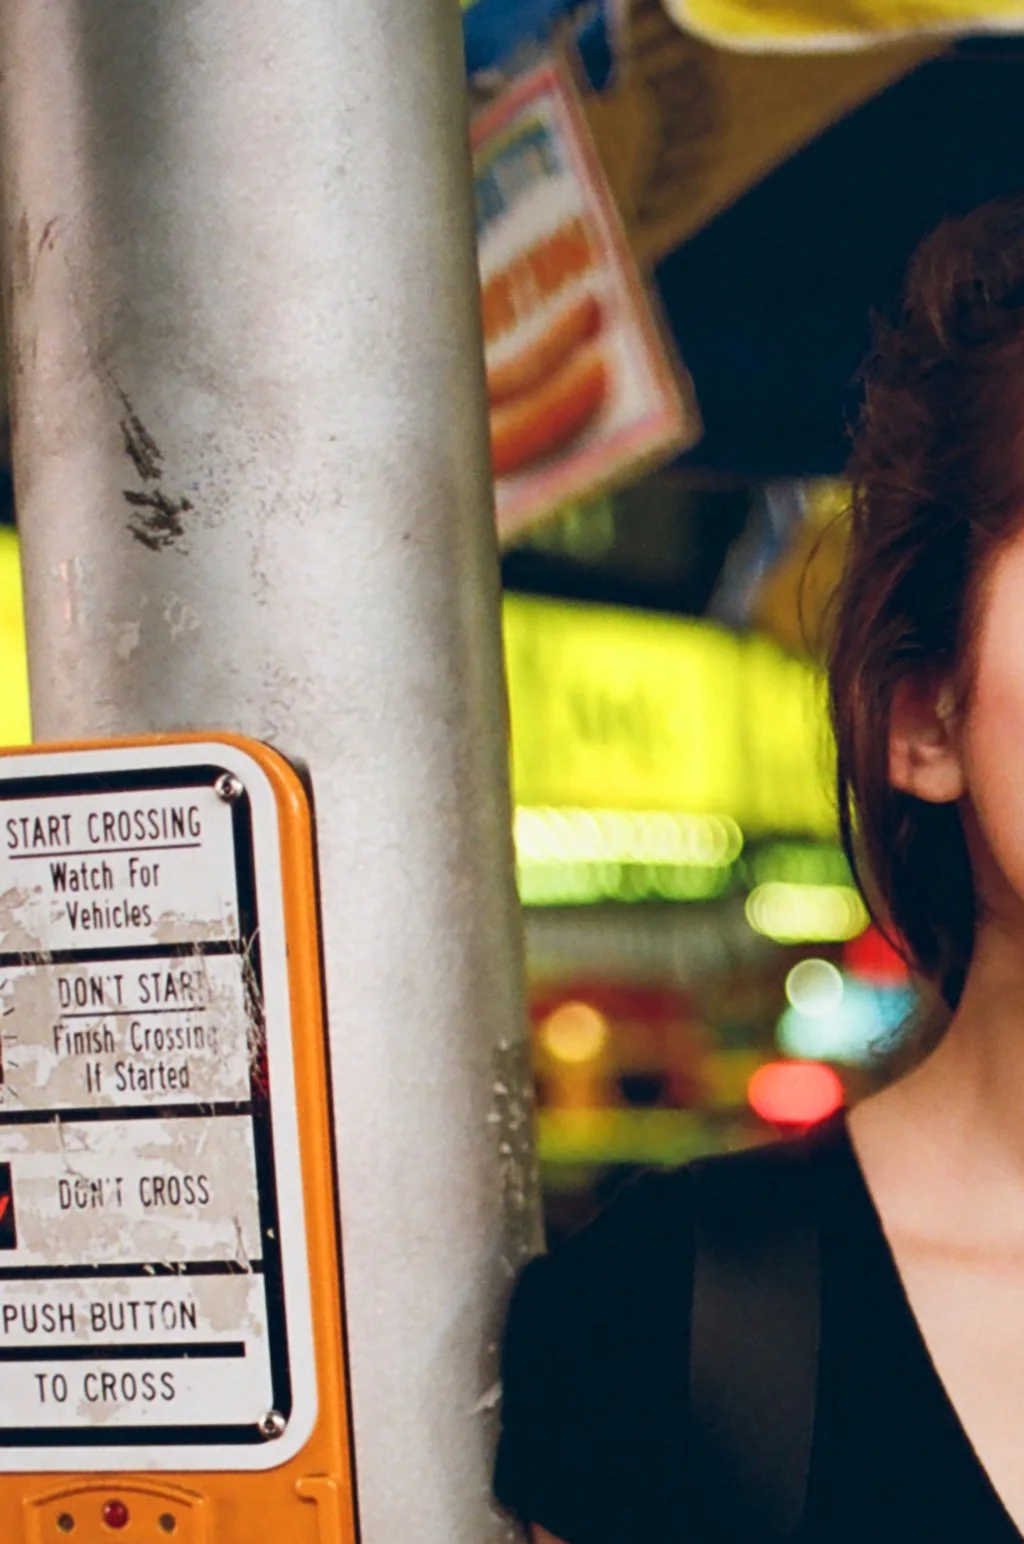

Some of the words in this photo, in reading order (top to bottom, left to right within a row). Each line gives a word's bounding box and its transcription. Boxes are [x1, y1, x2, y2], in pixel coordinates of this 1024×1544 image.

[6, 816, 72, 849] START
[87, 806, 202, 844] CROSSING
[50, 860, 114, 893] Watch
[129, 857, 161, 888] For
[66, 898, 153, 931] Vehicles
[57, 974, 123, 1008] DON'T
[53, 1023, 115, 1055] Finish
[86, 1062, 102, 1093] If
[114, 1059, 190, 1092] Started
[57, 1177, 123, 1210] DON'T
[139, 1174, 210, 1208] CROSS
[2, 1303, 76, 1333] PUSH
[90, 1300, 197, 1332] BUTTON
[34, 1373, 68, 1403] TO
[83, 1371, 176, 1402] CROSS
